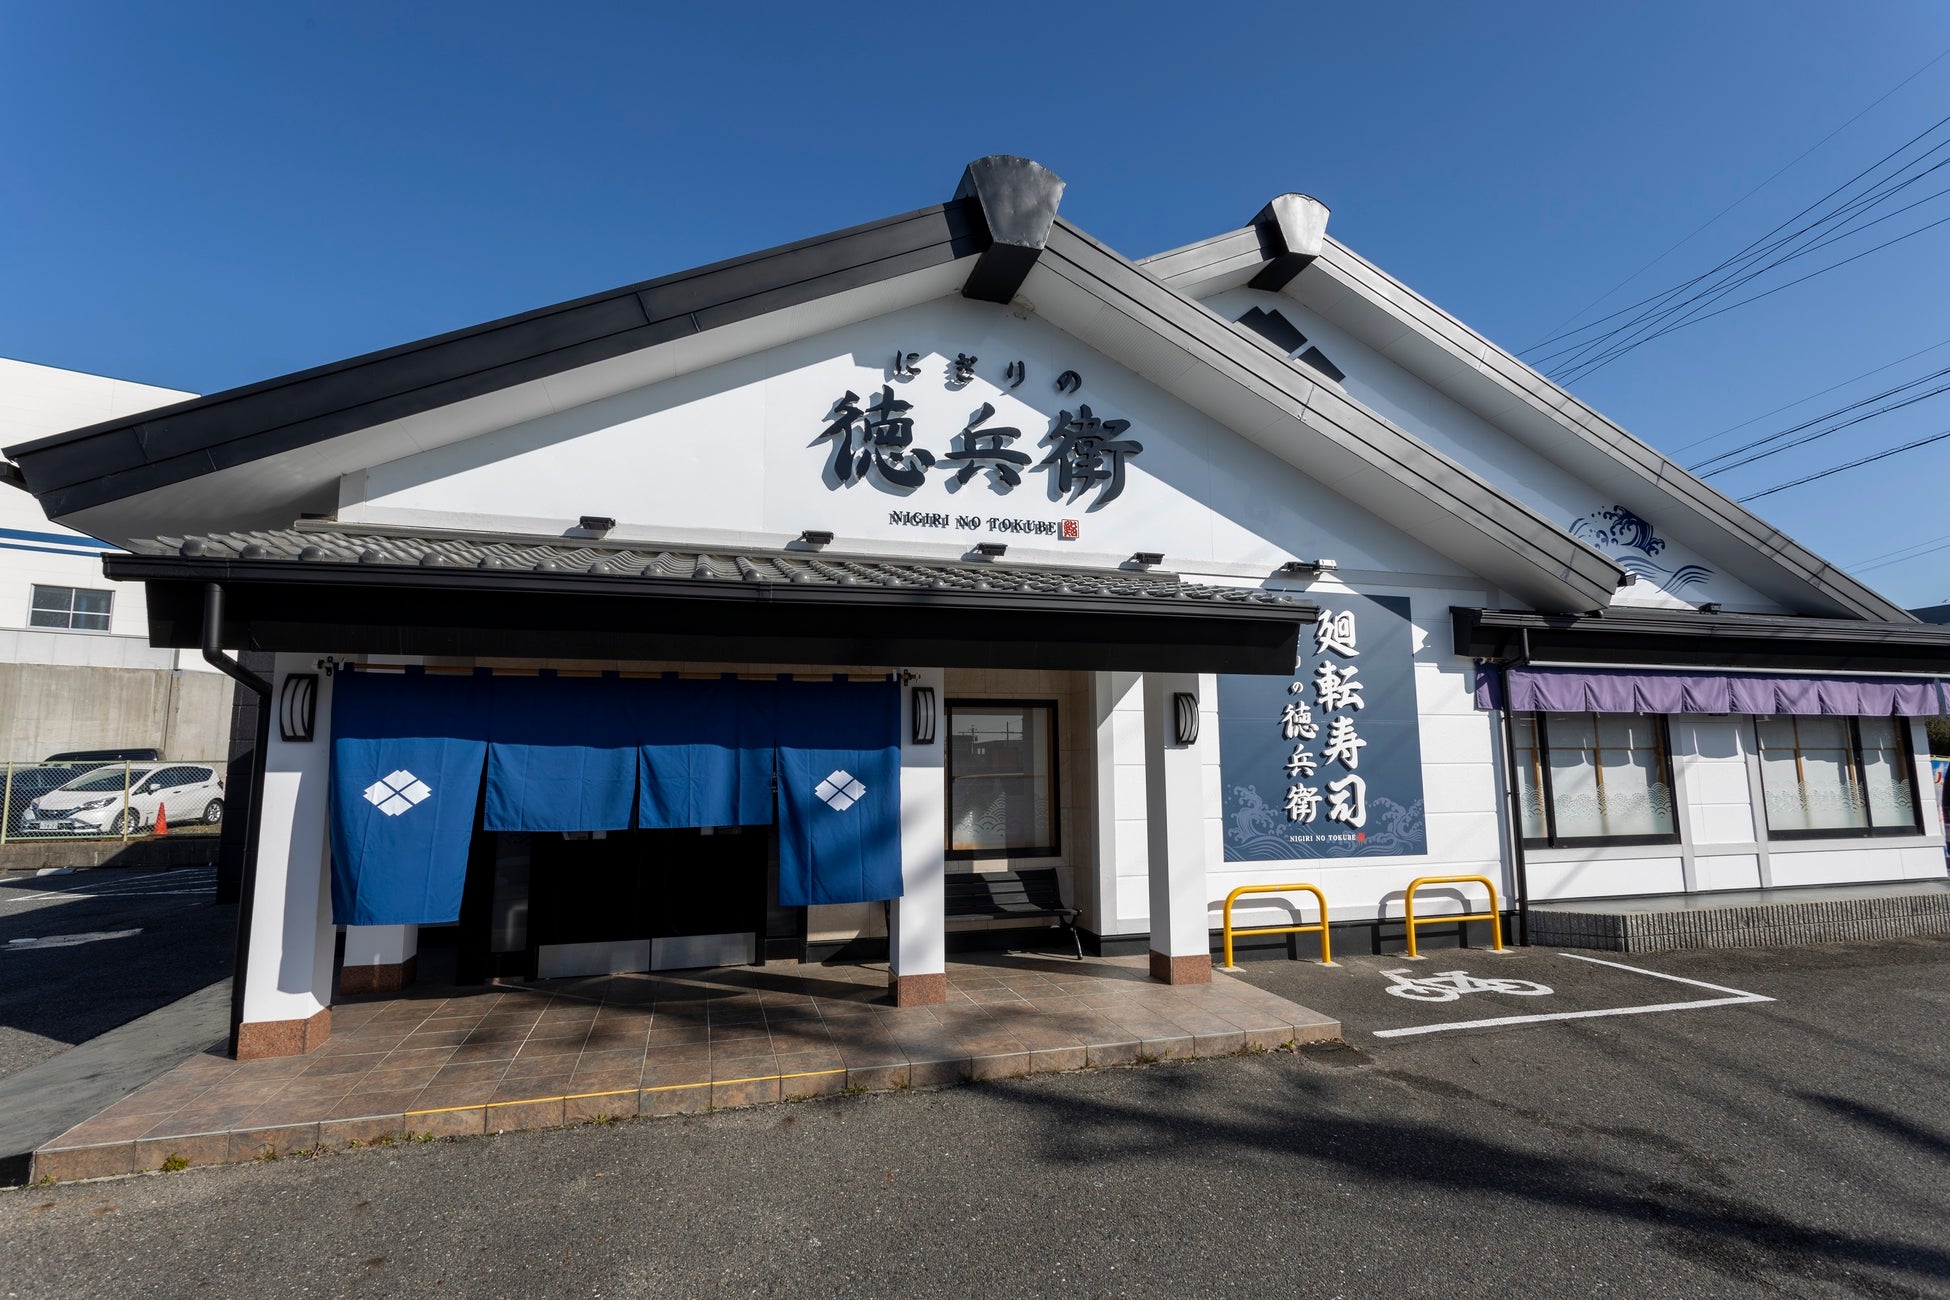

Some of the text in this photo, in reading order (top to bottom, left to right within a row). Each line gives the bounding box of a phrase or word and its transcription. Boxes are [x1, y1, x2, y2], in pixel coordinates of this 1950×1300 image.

[896, 350, 1082, 394] にぎりの
[813, 384, 1143, 508] 徳兵衛
[891, 510, 1057, 535] NIGIRI NO TOKUBE
[1316, 609, 1367, 828] 廻転寿司
[1315, 834, 1325, 842] NO
